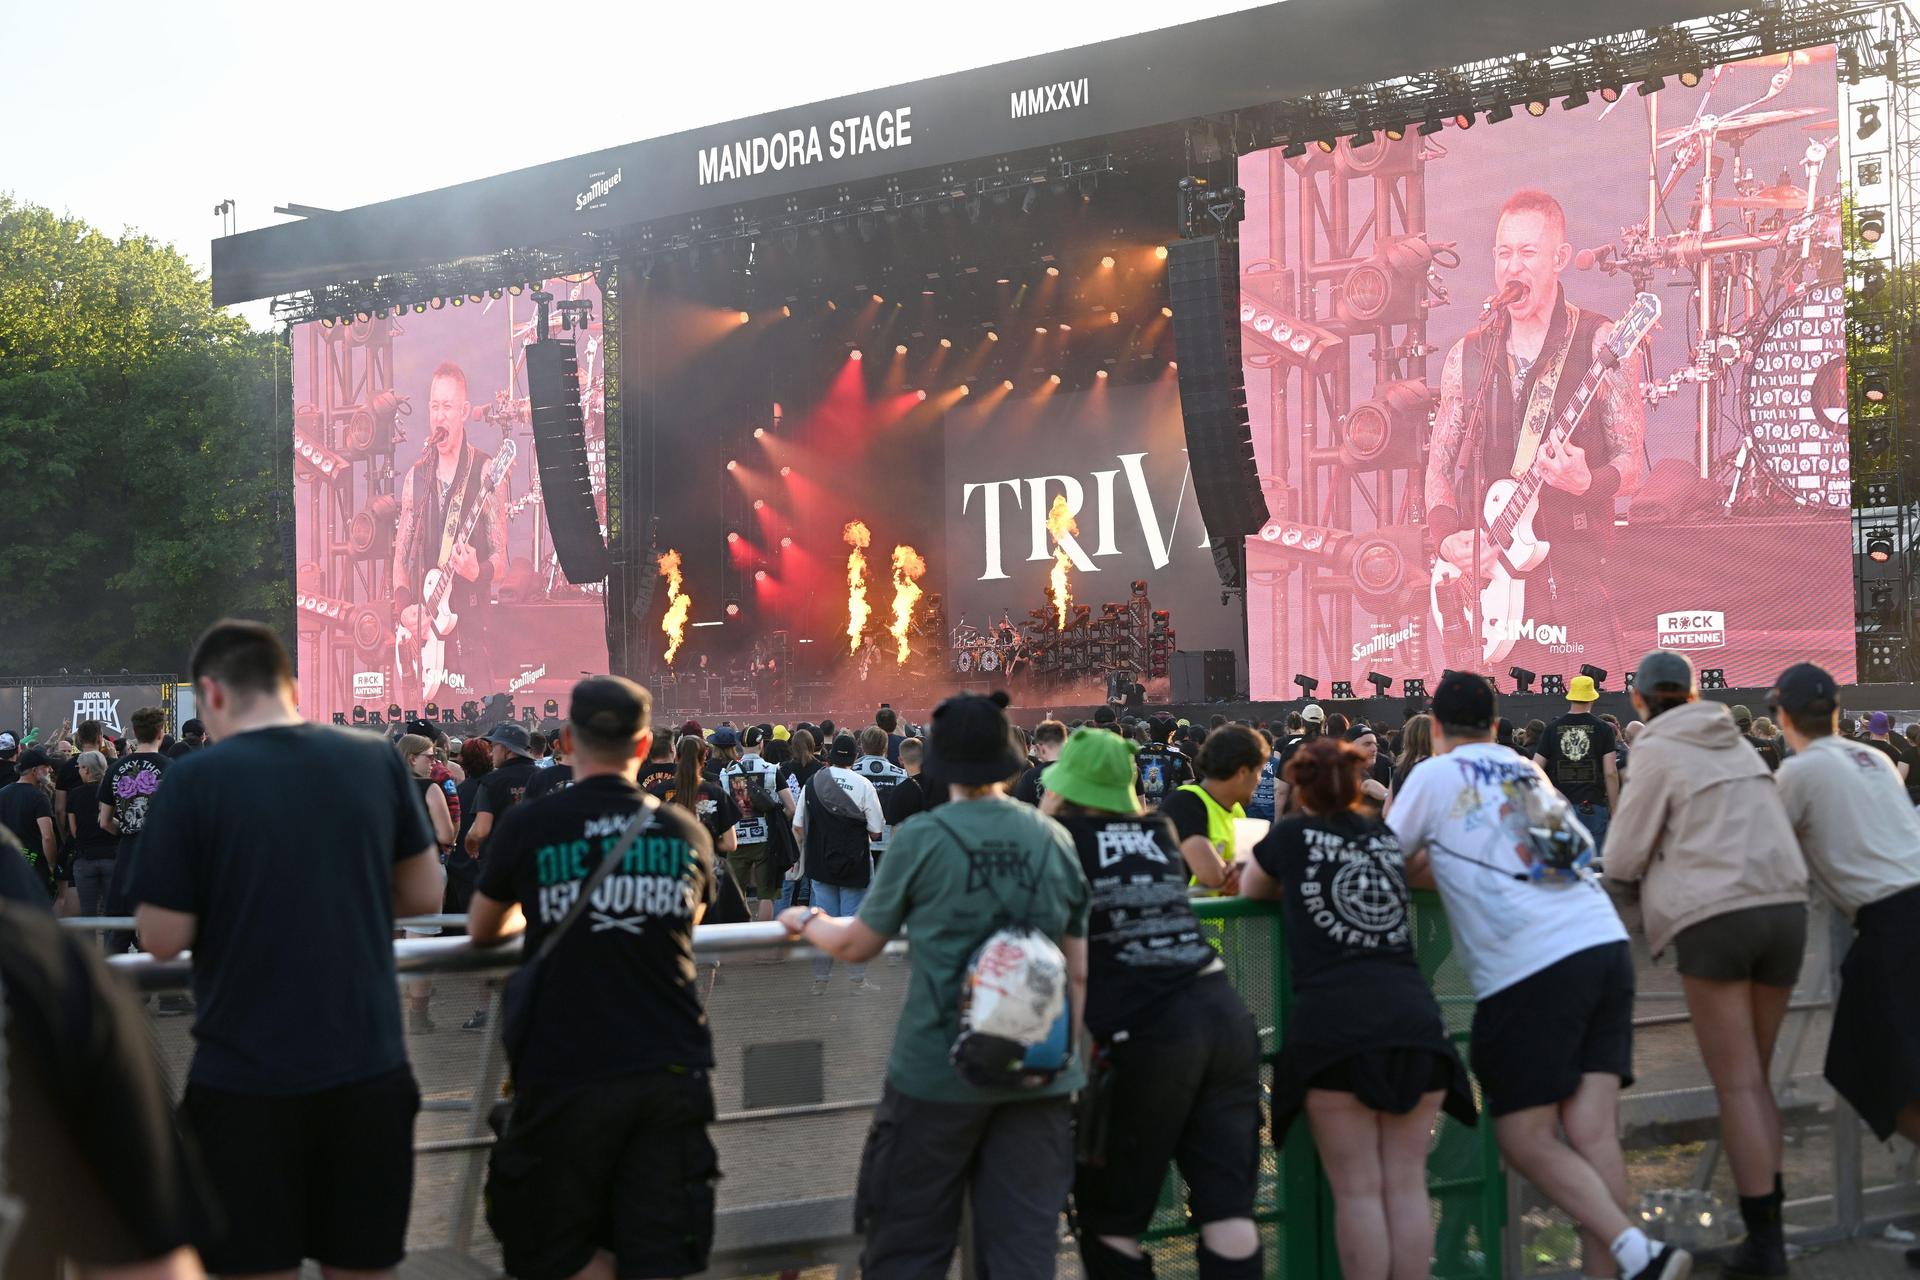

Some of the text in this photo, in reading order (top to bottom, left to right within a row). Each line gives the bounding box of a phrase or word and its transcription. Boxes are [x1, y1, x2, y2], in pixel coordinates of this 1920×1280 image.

[1011, 77, 1089, 119] MMXXVI
[698, 106, 912, 186] MANDORA STAGE
[962, 448, 1212, 581] TRIV
[1668, 615, 1713, 630] ROCK
[1661, 632, 1721, 645] ANTENNE
[1549, 642, 1585, 654] mobile
[358, 675, 379, 685] ROCK
[82, 691, 111, 700] ROCK IM
[355, 685, 383, 696] ANTENNE
[456, 686, 475, 695] mobile
[72, 698, 122, 735] PARK
[111, 773, 121, 796] THE
[141, 760, 162, 776] THE
[1302, 828, 1345, 846] THE
[536, 839, 592, 886] DIE
[1300, 881, 1381, 948] BROKEN
